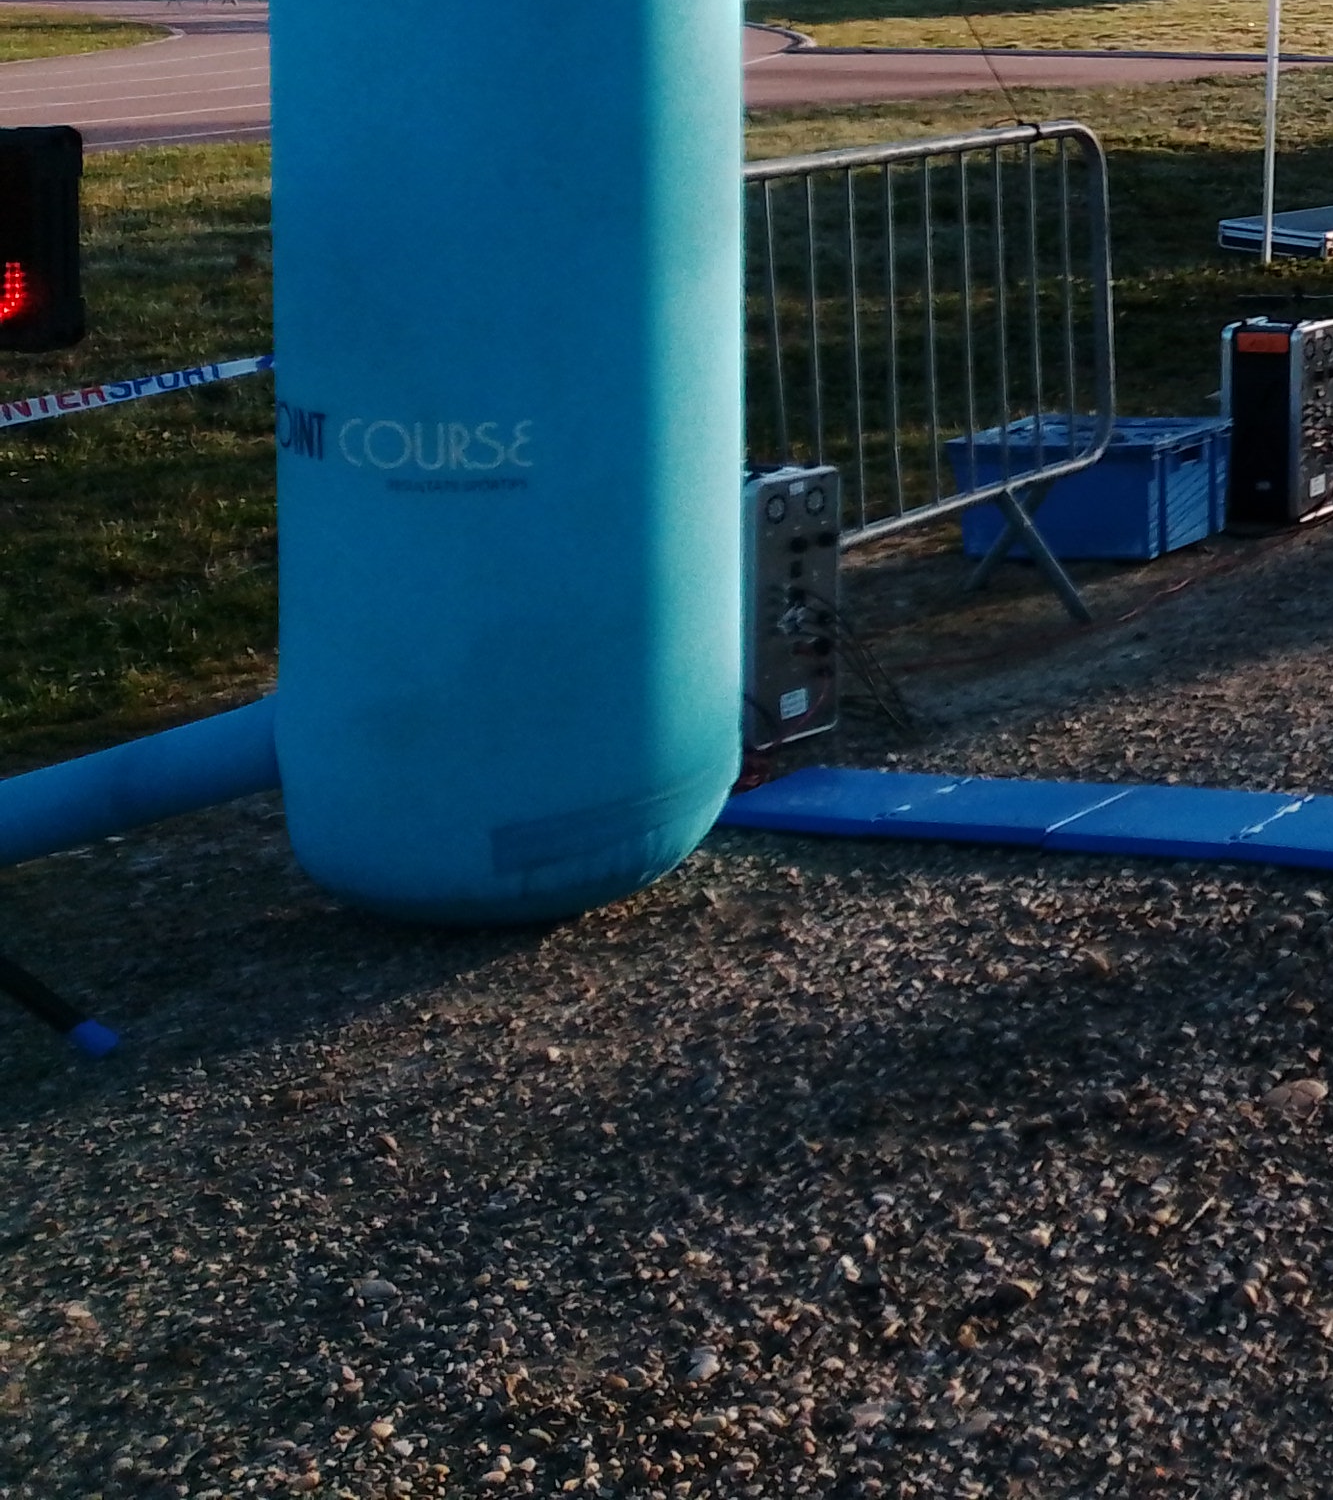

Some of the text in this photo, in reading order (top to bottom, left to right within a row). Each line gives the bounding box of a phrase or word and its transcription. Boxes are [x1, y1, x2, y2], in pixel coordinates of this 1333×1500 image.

[0, 363, 221, 421] NTERSPORT
[276, 400, 534, 471] OINT COURSE
